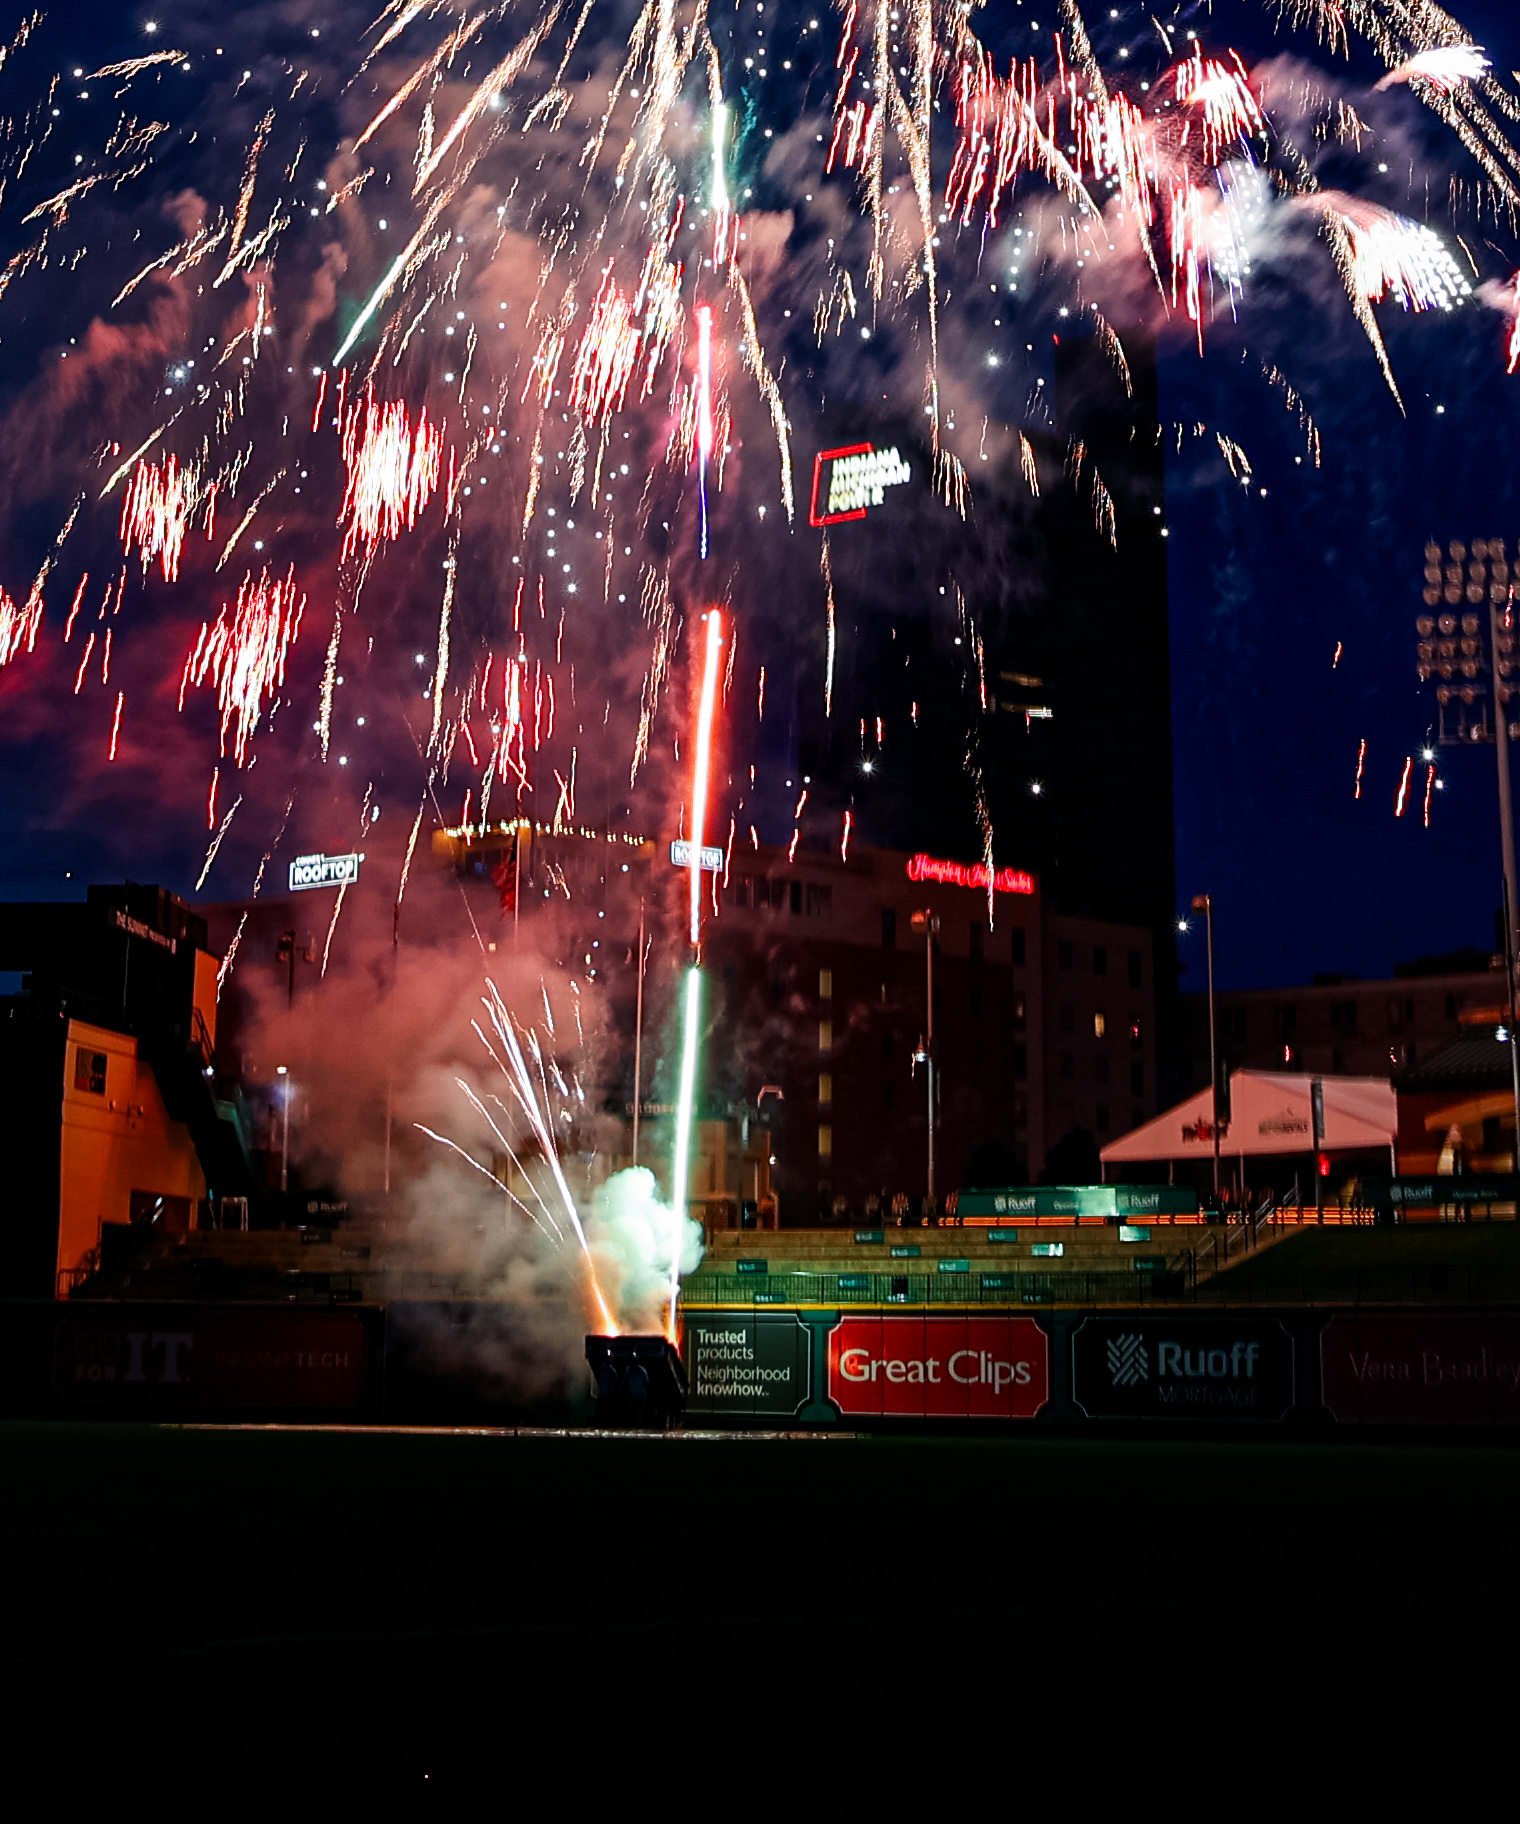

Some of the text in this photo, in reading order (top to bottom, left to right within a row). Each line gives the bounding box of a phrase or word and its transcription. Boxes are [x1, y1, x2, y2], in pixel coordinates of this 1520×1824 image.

[294, 860, 354, 885] ROOFTOP
[1007, 1194, 1036, 1210] Ruoff
[1130, 1193, 1159, 1208] Ruoff
[73, 1331, 122, 1362] GO
[696, 1329, 746, 1345] Trusted
[214, 1348, 351, 1369] INDIANA TECH
[697, 1346, 754, 1364] products
[1156, 1339, 1260, 1379] Ruoff
[1347, 1347, 1412, 1384] Vera
[74, 1363, 118, 1383] FOR
[696, 1365, 791, 1383] Neighborhood
[838, 1347, 1032, 1395] Great Clips
[1157, 1383, 1259, 1409] MORTGAGE
